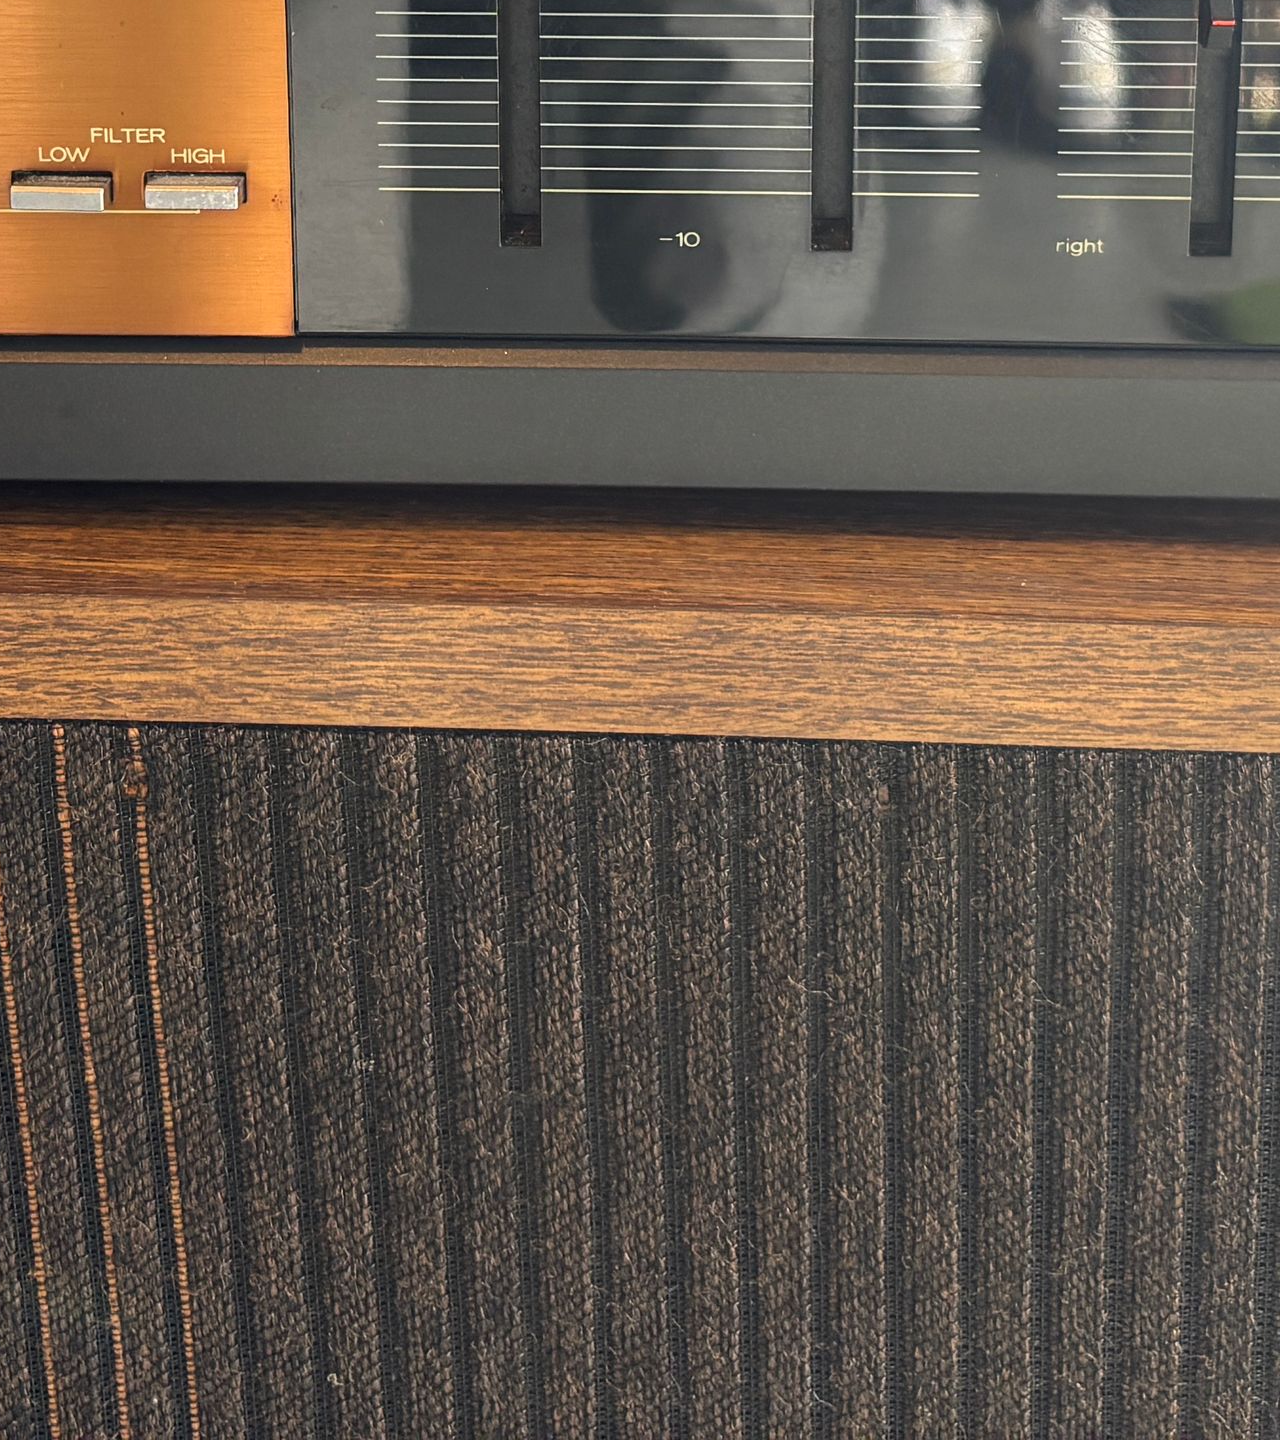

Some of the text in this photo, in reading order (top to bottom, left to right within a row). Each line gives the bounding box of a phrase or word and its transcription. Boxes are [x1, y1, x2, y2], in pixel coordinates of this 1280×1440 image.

[90, 127, 166, 144] FILTER
[38, 146, 91, 163] LOW
[170, 147, 226, 164] HIGH
[1055, 238, 1104, 257] right
